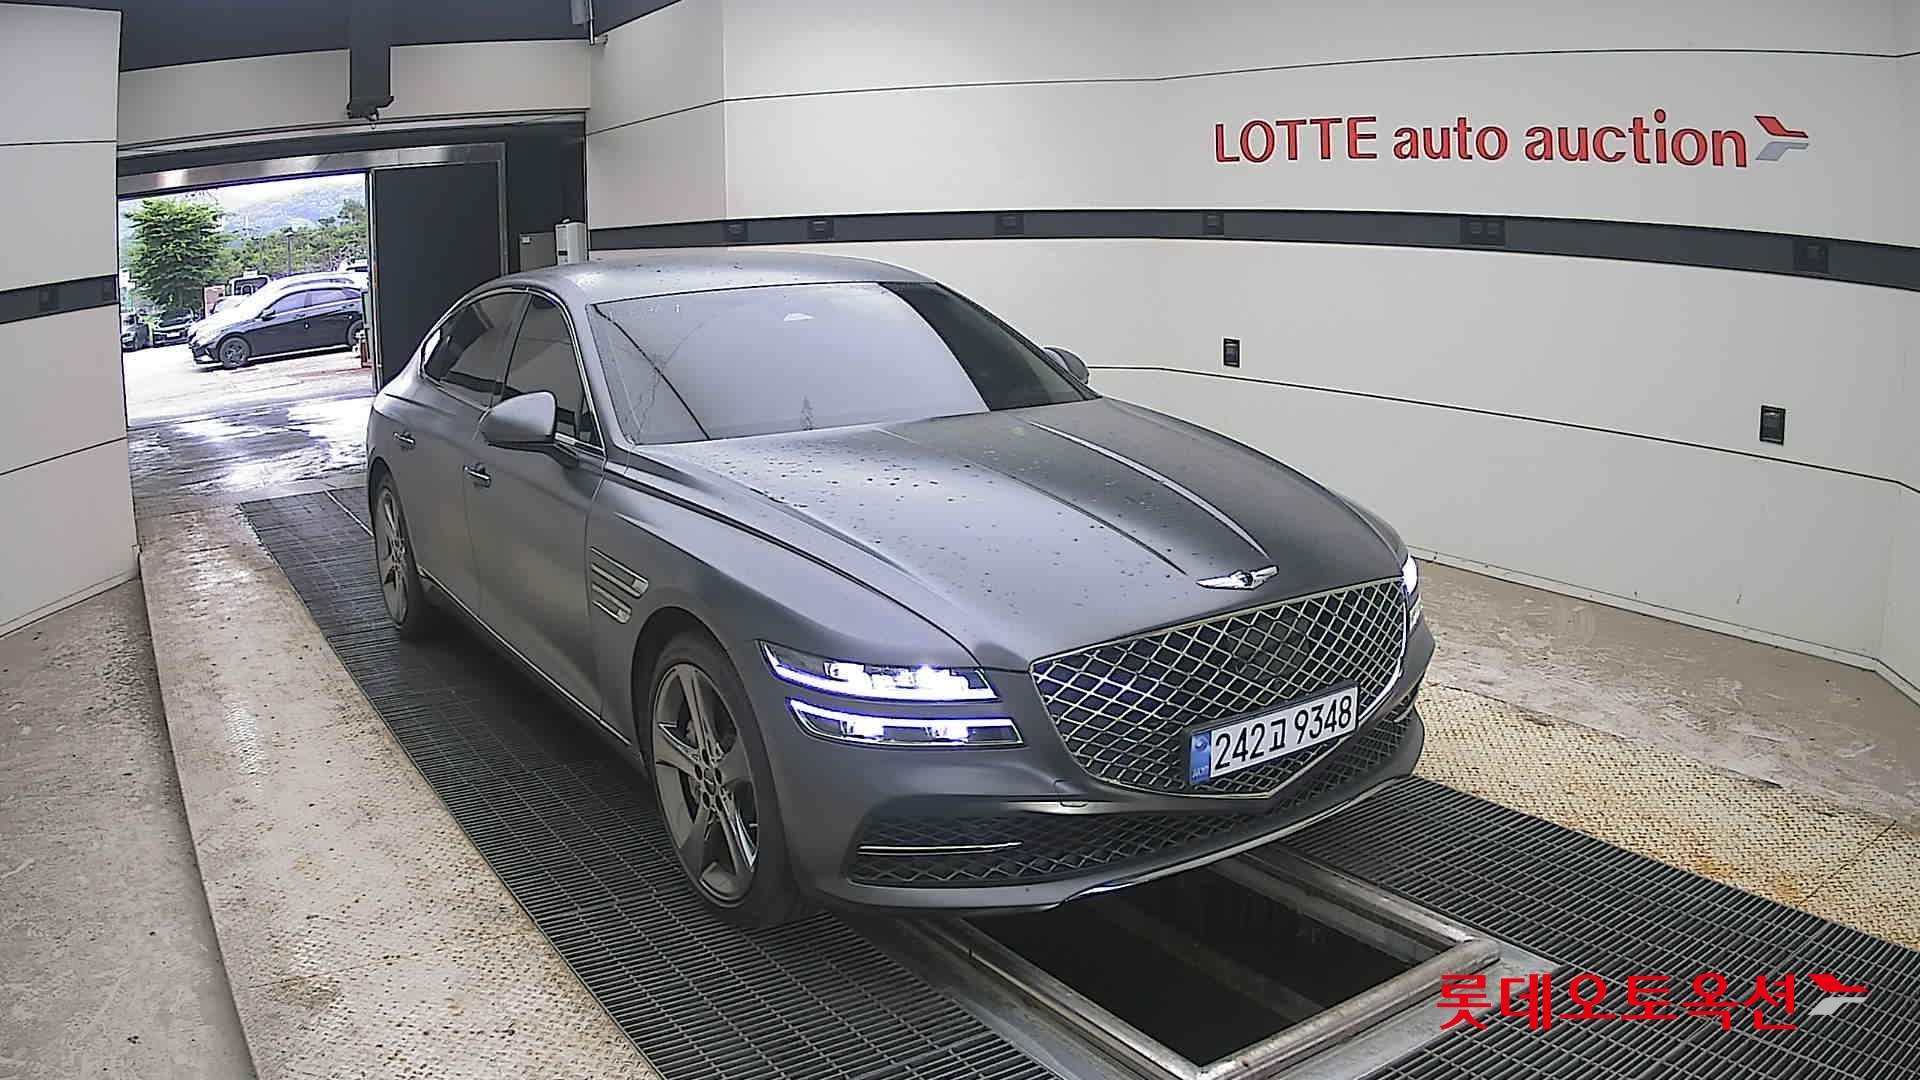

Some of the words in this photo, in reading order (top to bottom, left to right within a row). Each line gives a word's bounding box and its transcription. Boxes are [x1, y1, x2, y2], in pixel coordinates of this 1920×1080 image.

[1215, 116, 1377, 163] LOTTE
[1393, 118, 1509, 162] auto
[1524, 109, 1747, 168] auction
[1294, 696, 1352, 745] 9348
